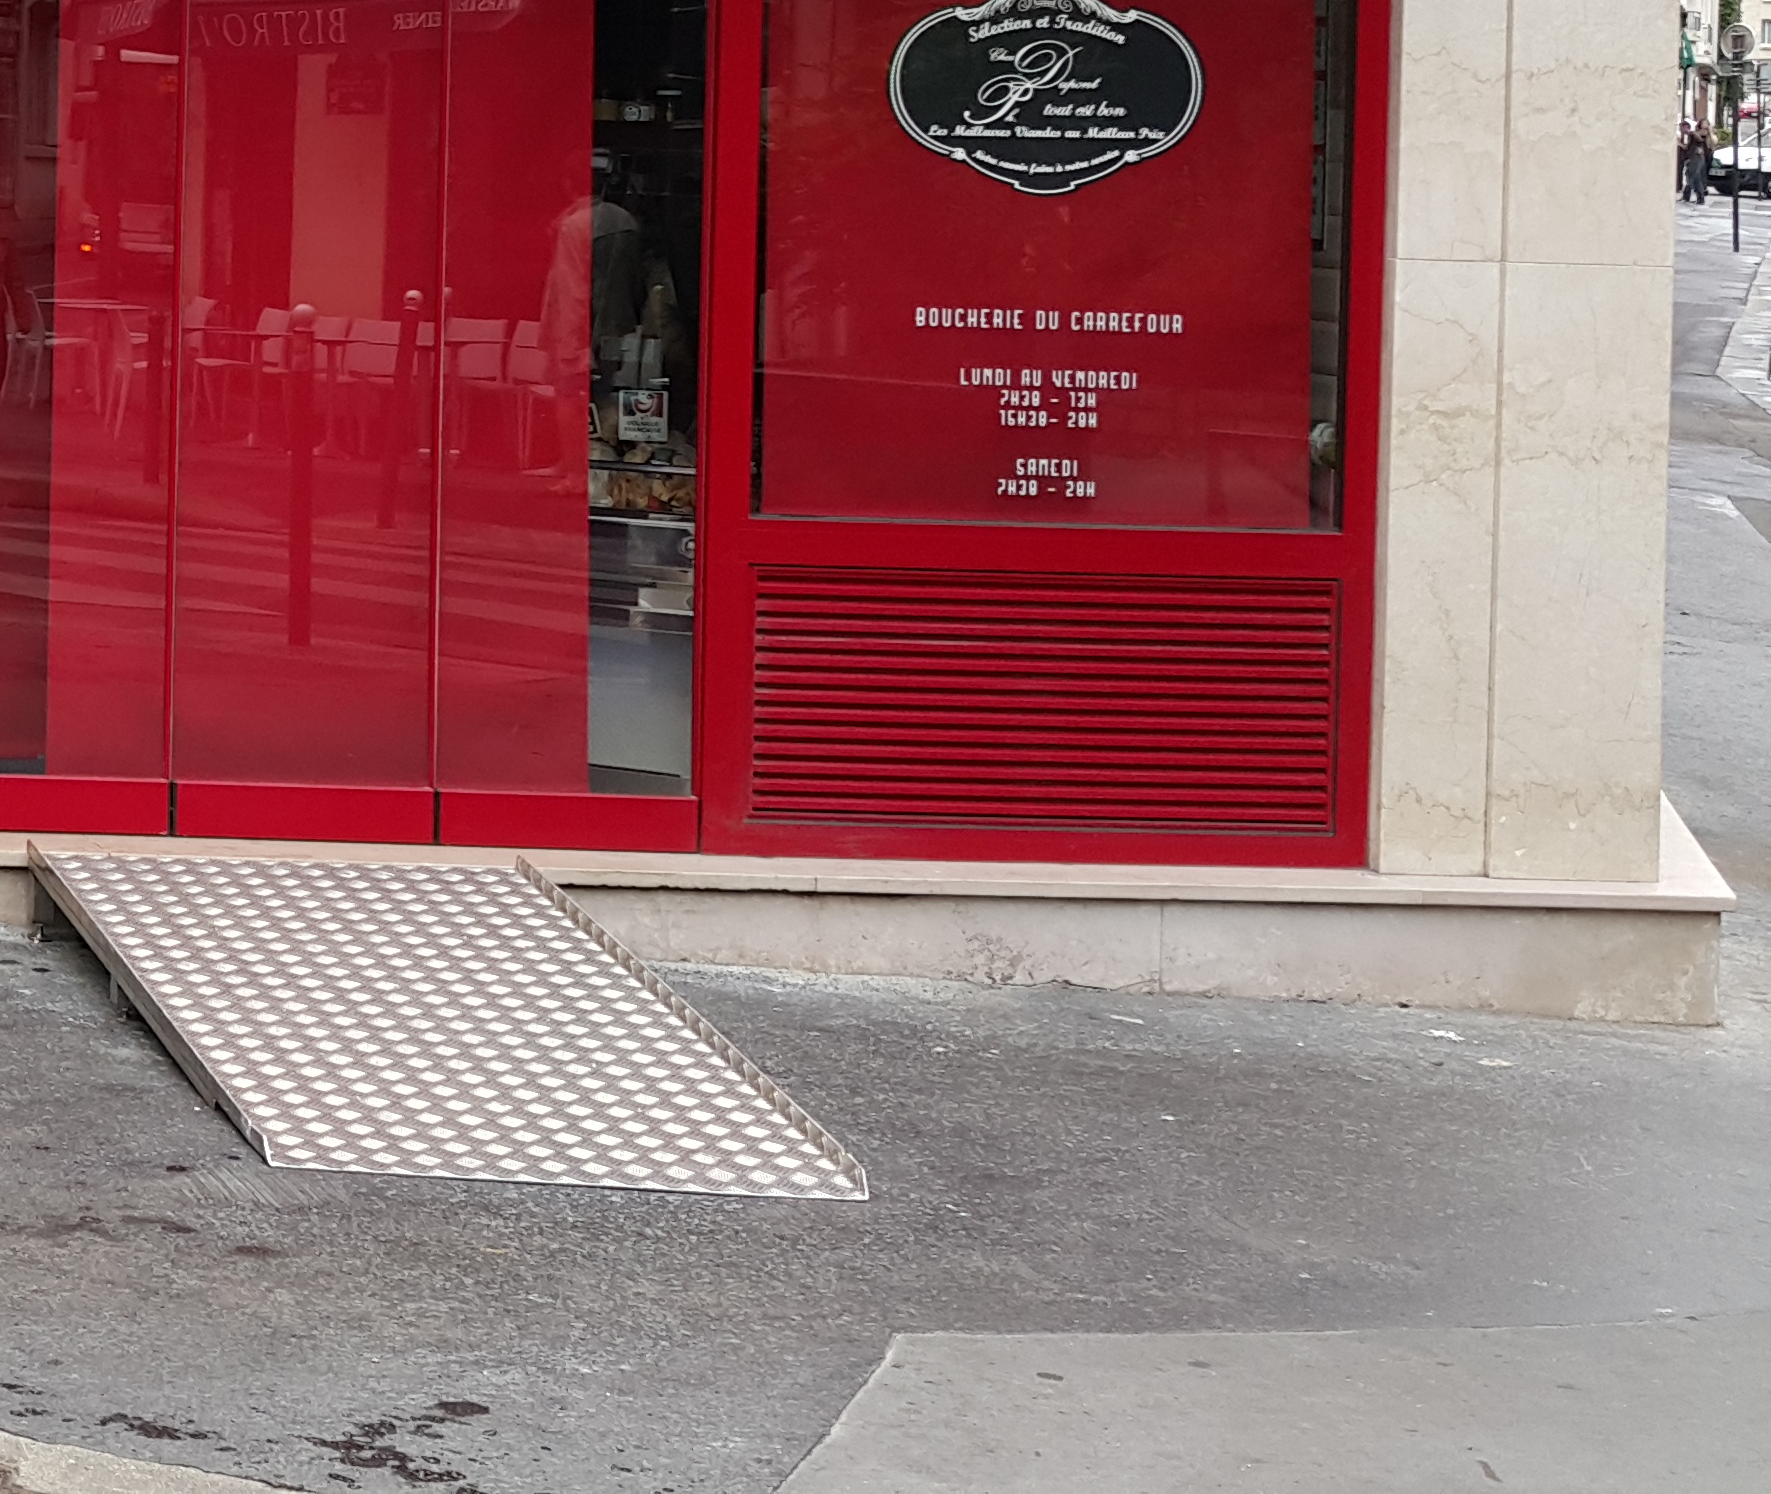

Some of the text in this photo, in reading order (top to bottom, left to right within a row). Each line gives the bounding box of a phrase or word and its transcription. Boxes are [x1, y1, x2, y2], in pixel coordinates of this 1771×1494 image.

[968, 14, 1128, 44] Sélection et Tradition
[1043, 101, 1127, 117] tout est bon
[928, 125, 948, 137] Les
[1014, 126, 1061, 138] Viandes
[1138, 127, 1166, 140] Prix
[916, 307, 1184, 334] BOUCHERIE DU CARREFOUR
[960, 368, 1138, 389] LUNDI AU VENDREDI
[999, 390, 1041, 407] 7H30
[1069, 392, 1097, 407] 13H
[1067, 412, 1098, 428] 20H
[1015, 459, 1078, 477] SAMEDI
[997, 479, 1038, 496] 7H30
[1065, 481, 1096, 497] 20H
